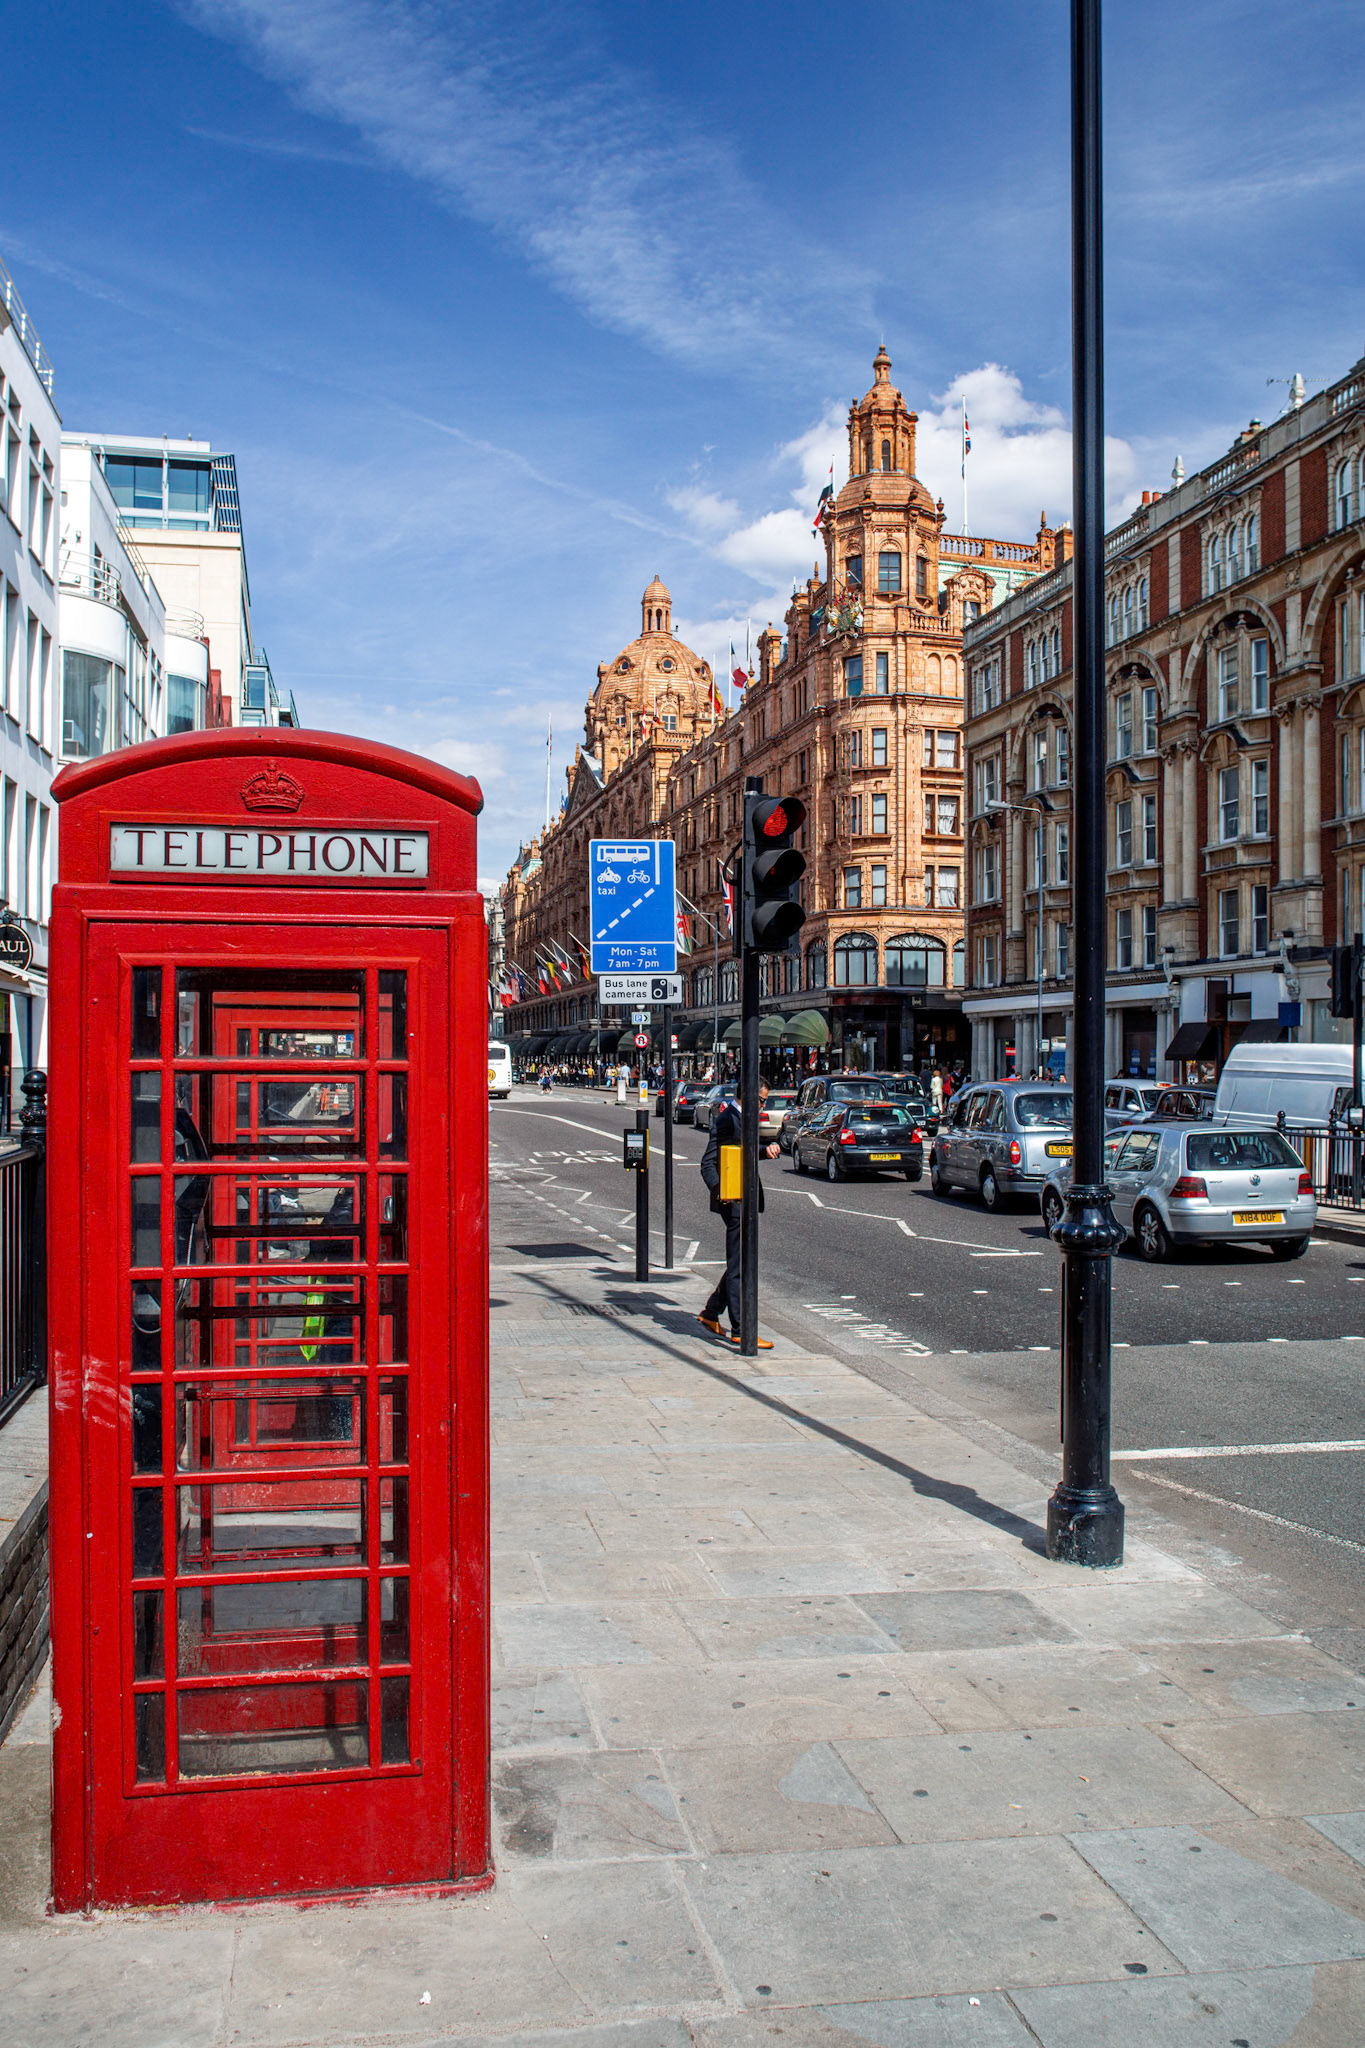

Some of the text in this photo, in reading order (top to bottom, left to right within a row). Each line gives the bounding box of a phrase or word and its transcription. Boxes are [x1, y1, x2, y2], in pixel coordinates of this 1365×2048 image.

[123, 829, 417, 873] TELEPHONE
[598, 886, 616, 895] taxi
[611, 947, 633, 956] Mon
[639, 947, 657, 956] Sat
[605, 979, 648, 988] Bus lane
[605, 991, 647, 999] cameras
